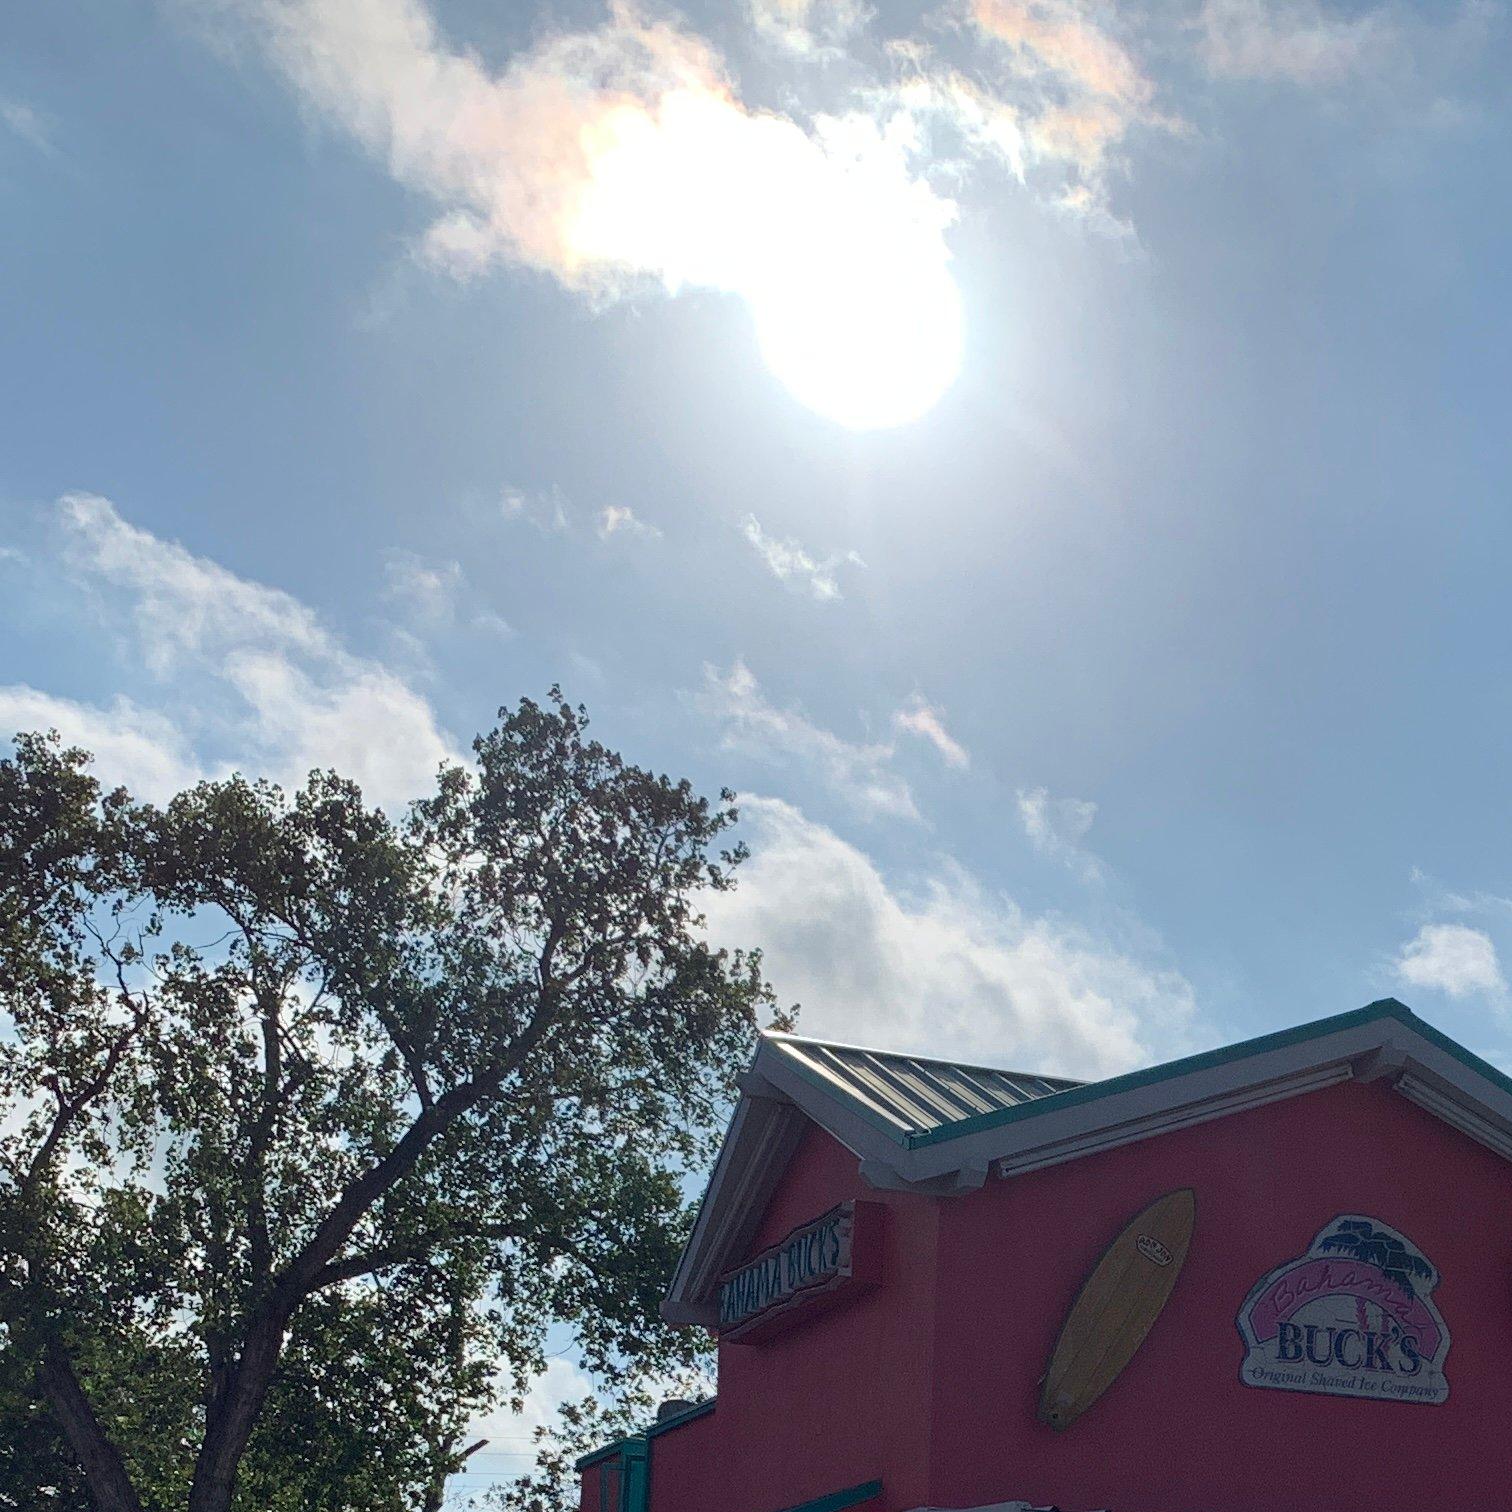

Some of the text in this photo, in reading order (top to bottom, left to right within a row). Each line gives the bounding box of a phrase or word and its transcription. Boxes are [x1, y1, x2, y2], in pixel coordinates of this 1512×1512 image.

[1272, 1265, 1426, 1331] Bahama
[1275, 1321, 1422, 1377] BUCK'S
[1248, 1366, 1441, 1399] Original Shaved Ice Company
